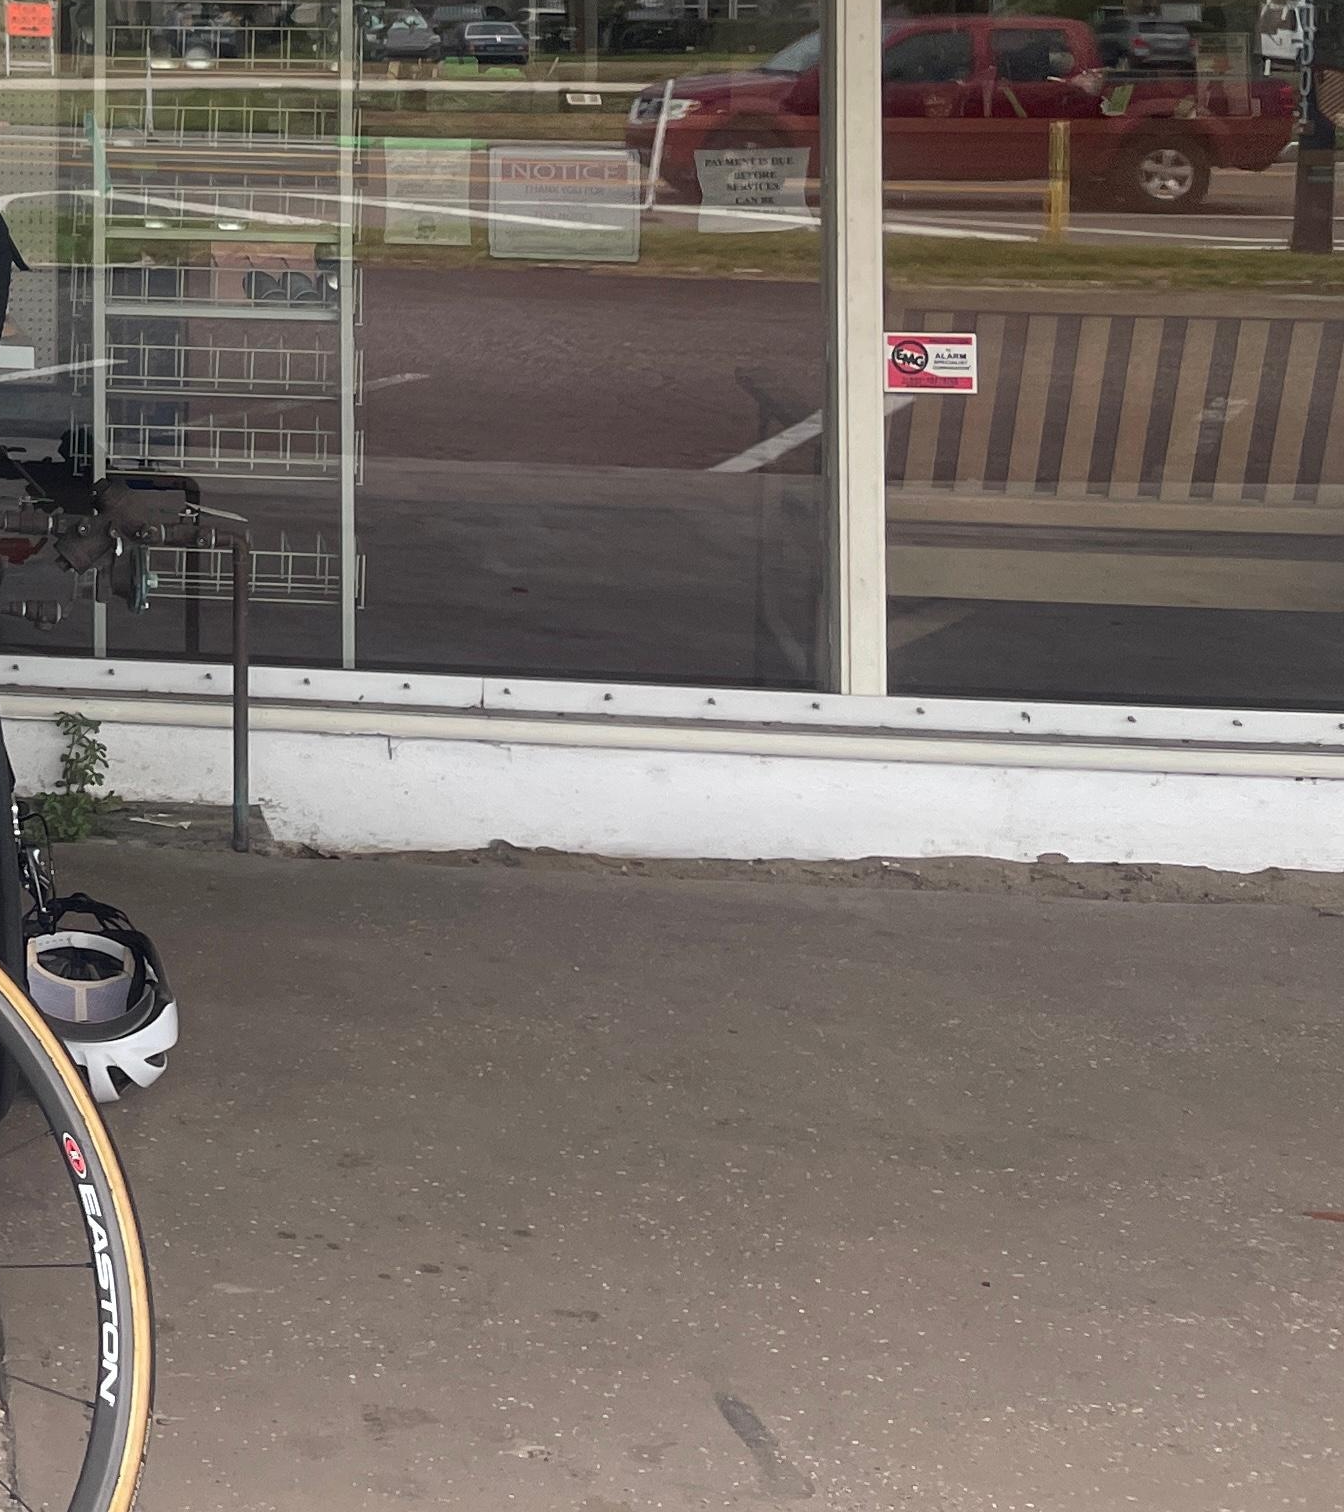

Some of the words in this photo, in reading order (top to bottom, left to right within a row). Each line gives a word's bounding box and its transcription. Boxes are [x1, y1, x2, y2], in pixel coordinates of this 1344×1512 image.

[771, 156, 794, 166] DUE
[511, 162, 620, 181] NOTICE
[897, 348, 925, 367] EMG
[935, 352, 968, 360] ALARM
[77, 1182, 121, 1408] EASTON
